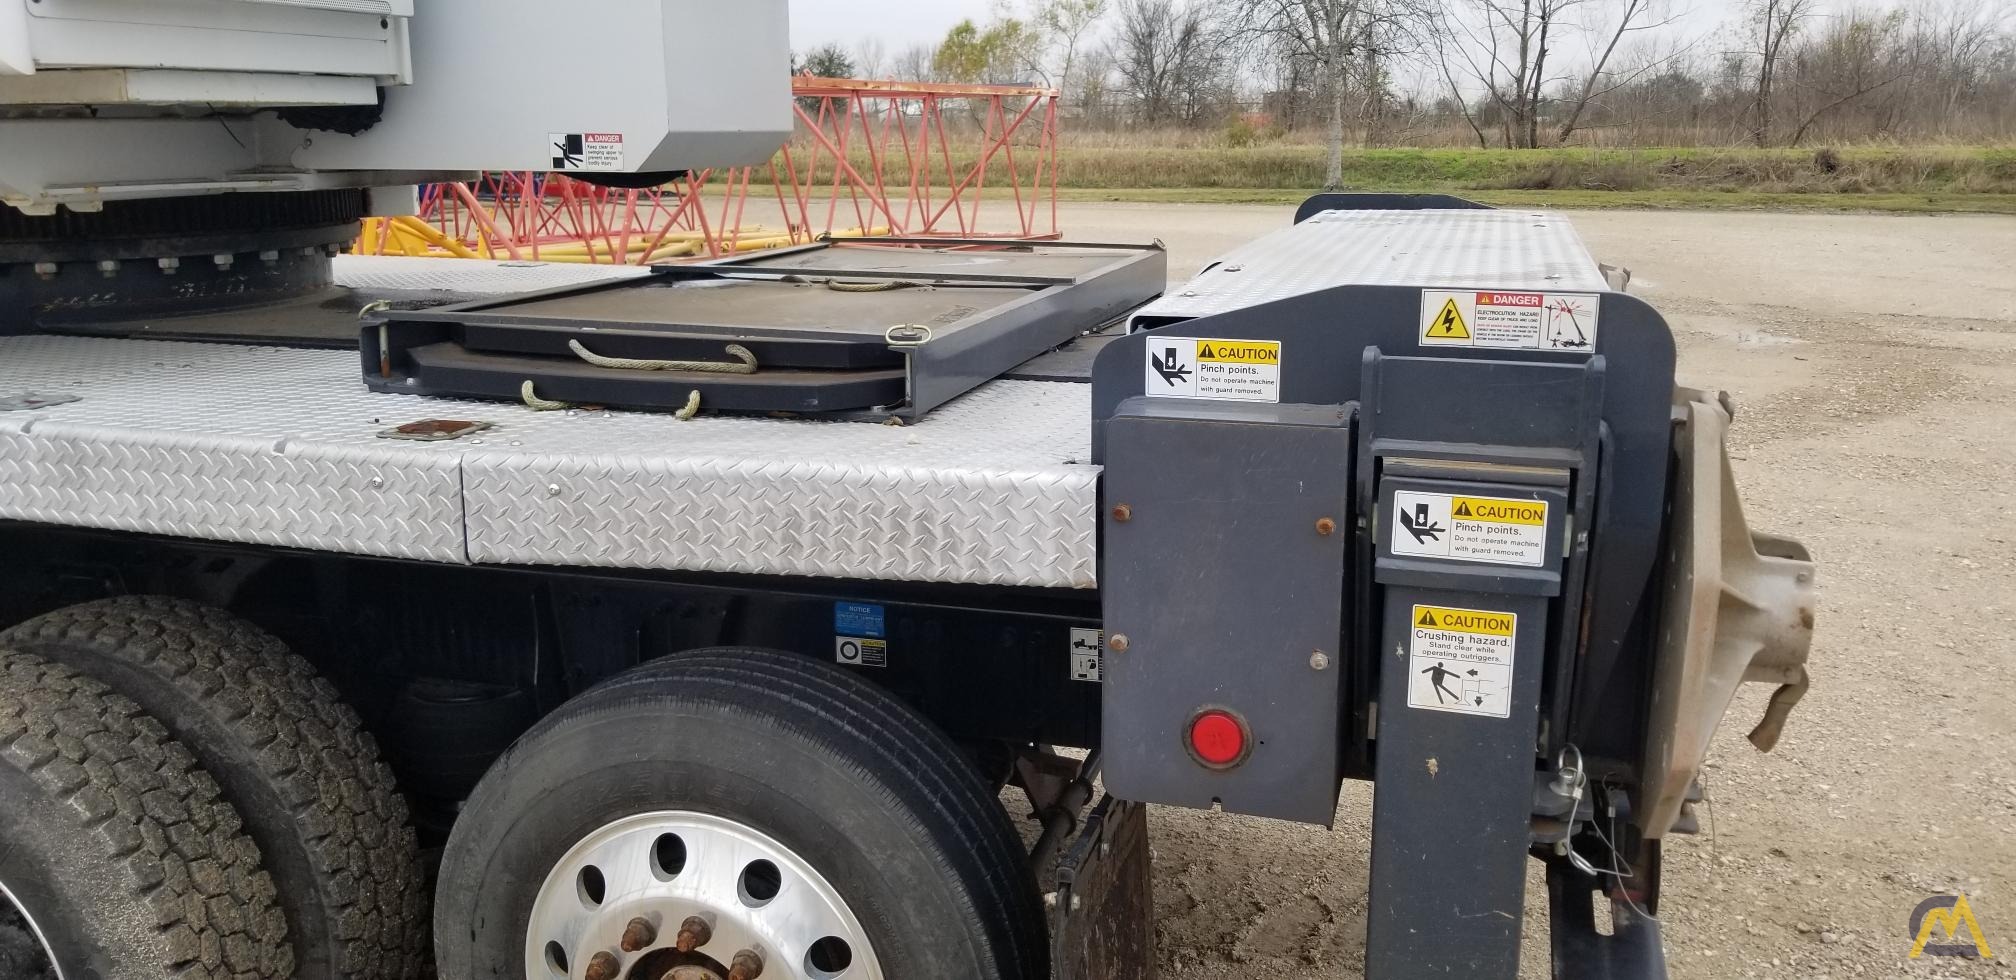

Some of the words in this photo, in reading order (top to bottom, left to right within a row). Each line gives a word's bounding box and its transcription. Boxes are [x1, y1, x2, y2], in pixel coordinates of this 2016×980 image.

[1493, 295, 1539, 305] DANGER
[1218, 347, 1277, 360] CAUTION
[1201, 364, 1225, 373] Pinch
[1228, 365, 1259, 375] points.
[1476, 505, 1543, 521] CAUTION
[1455, 522, 1483, 532] Pinch
[1487, 524, 1522, 536] points.
[1510, 540, 1539, 548] machine
[1493, 549, 1525, 557] removed.
[1443, 614, 1510, 631] CAUTION
[1416, 629, 1464, 644] Crushing
[1469, 634, 1510, 647] hazard.
[1429, 642, 1451, 650] Stand
[1454, 644, 1473, 652] clear
[1476, 645, 1495, 653] while
[1422, 649, 1458, 658] operating
[1460, 652, 1501, 662] outriggers.
